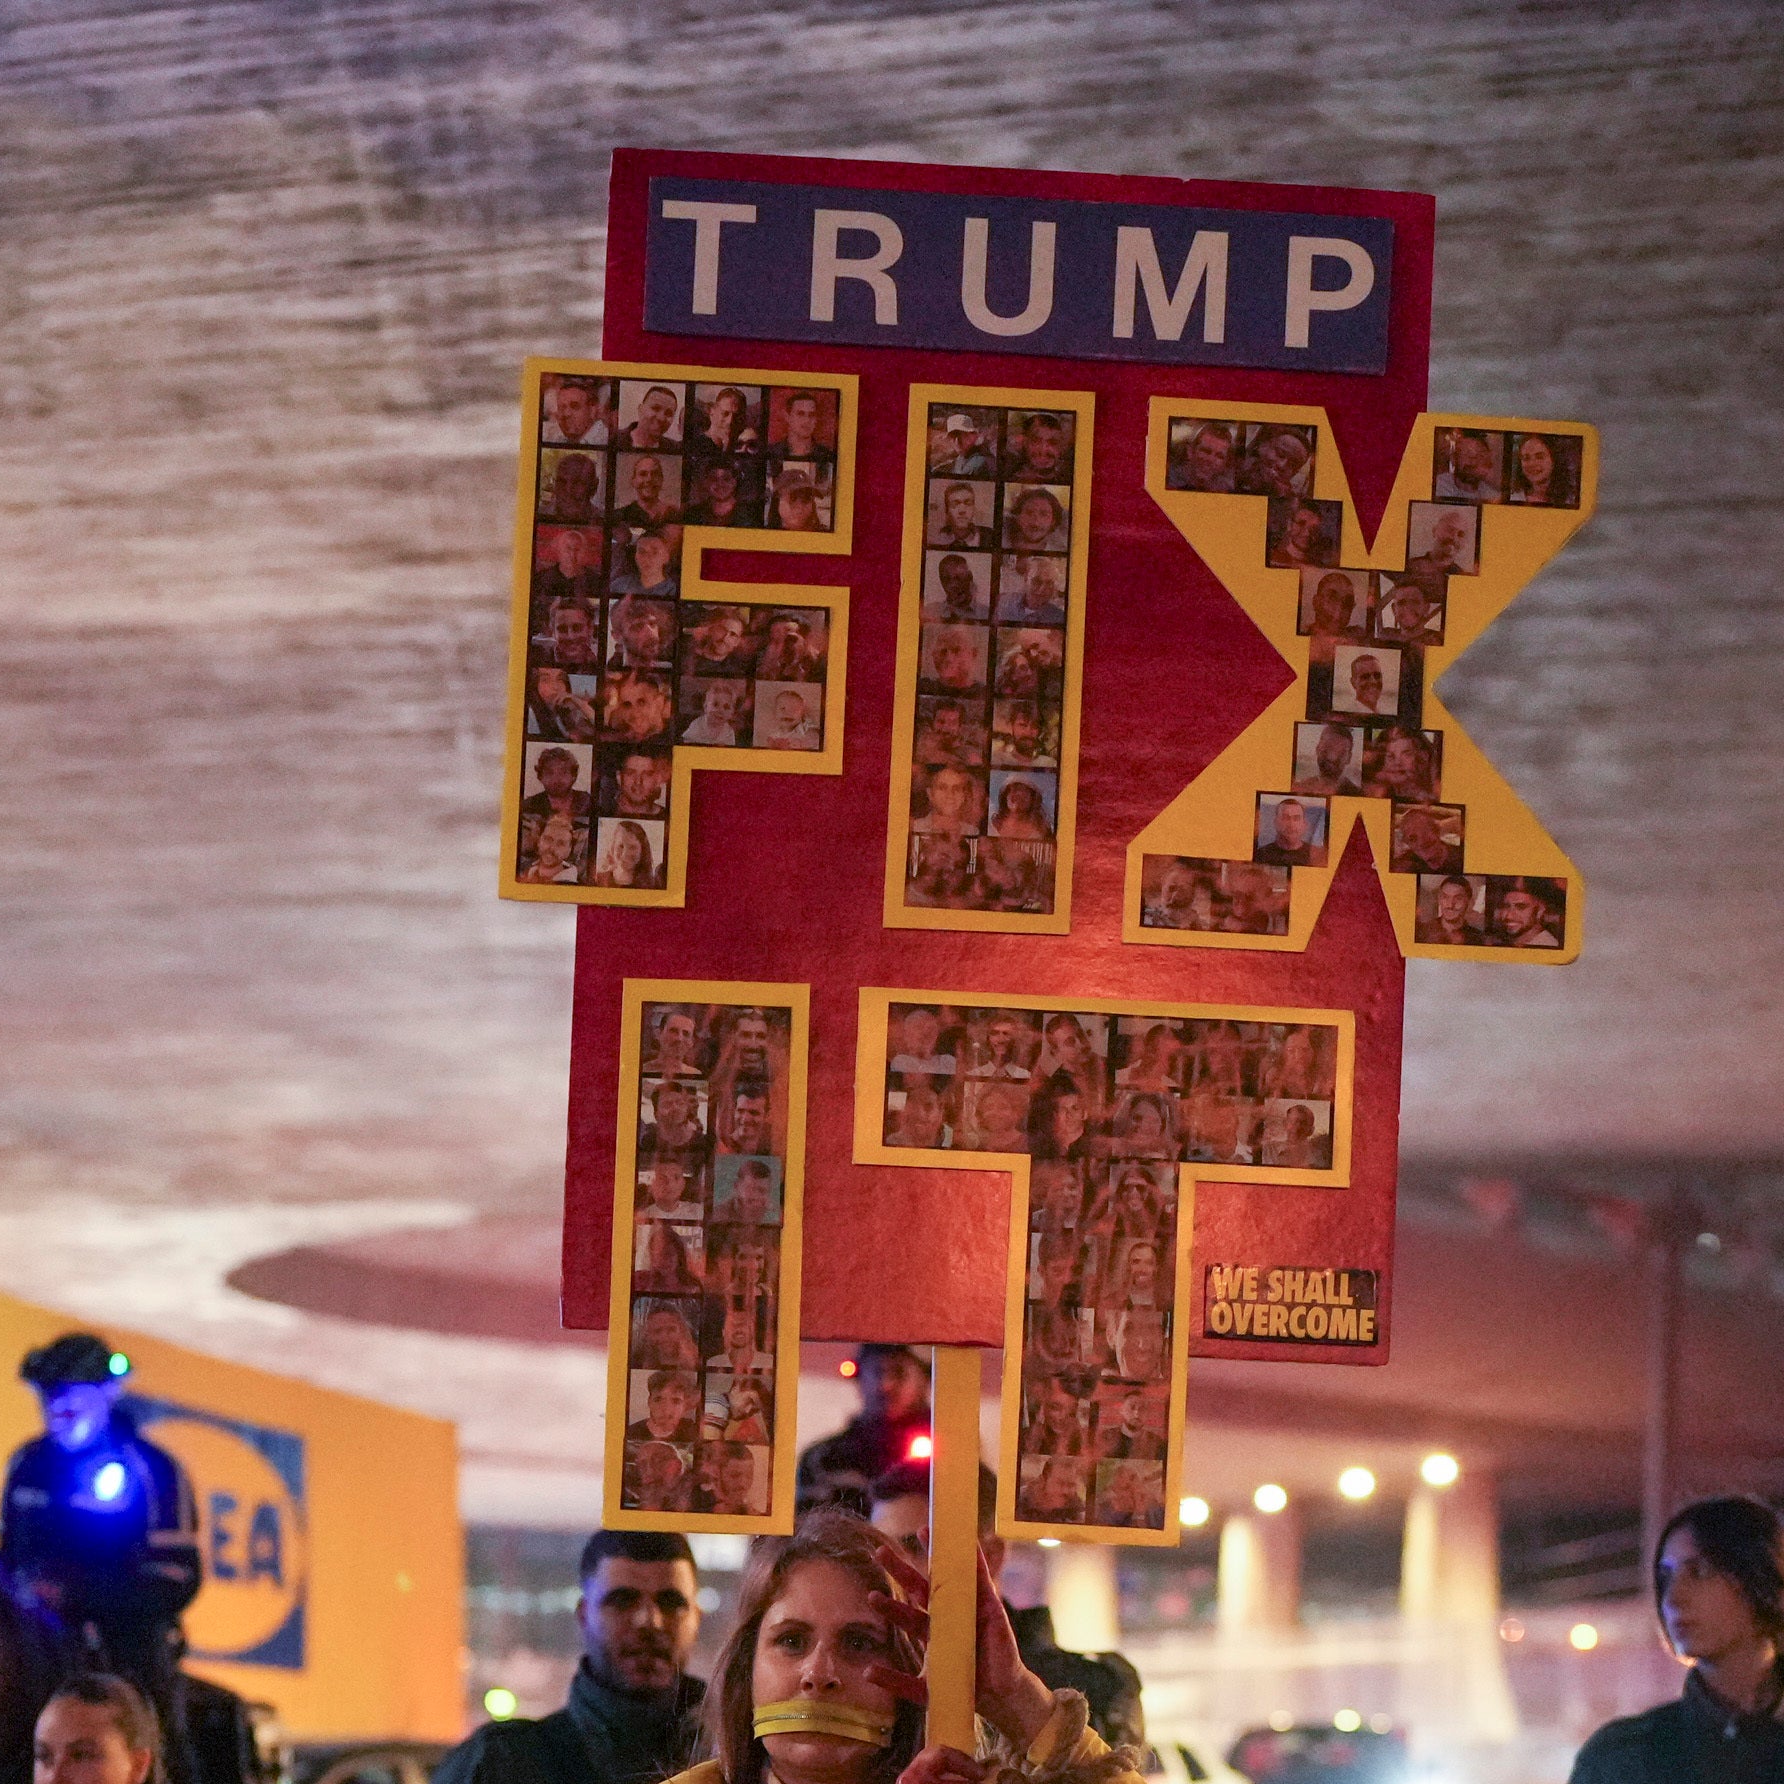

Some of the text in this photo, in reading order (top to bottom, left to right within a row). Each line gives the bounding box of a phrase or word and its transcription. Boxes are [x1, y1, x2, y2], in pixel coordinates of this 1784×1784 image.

[661, 199, 1376, 349] TRUMP
[499, 357, 1600, 964] FIX
[603, 978, 1356, 1548] IT
[1210, 1265, 1354, 1306] WE SHALL
[1210, 1301, 1376, 1342] OVERCOME
[208, 1490, 286, 1588] EA
